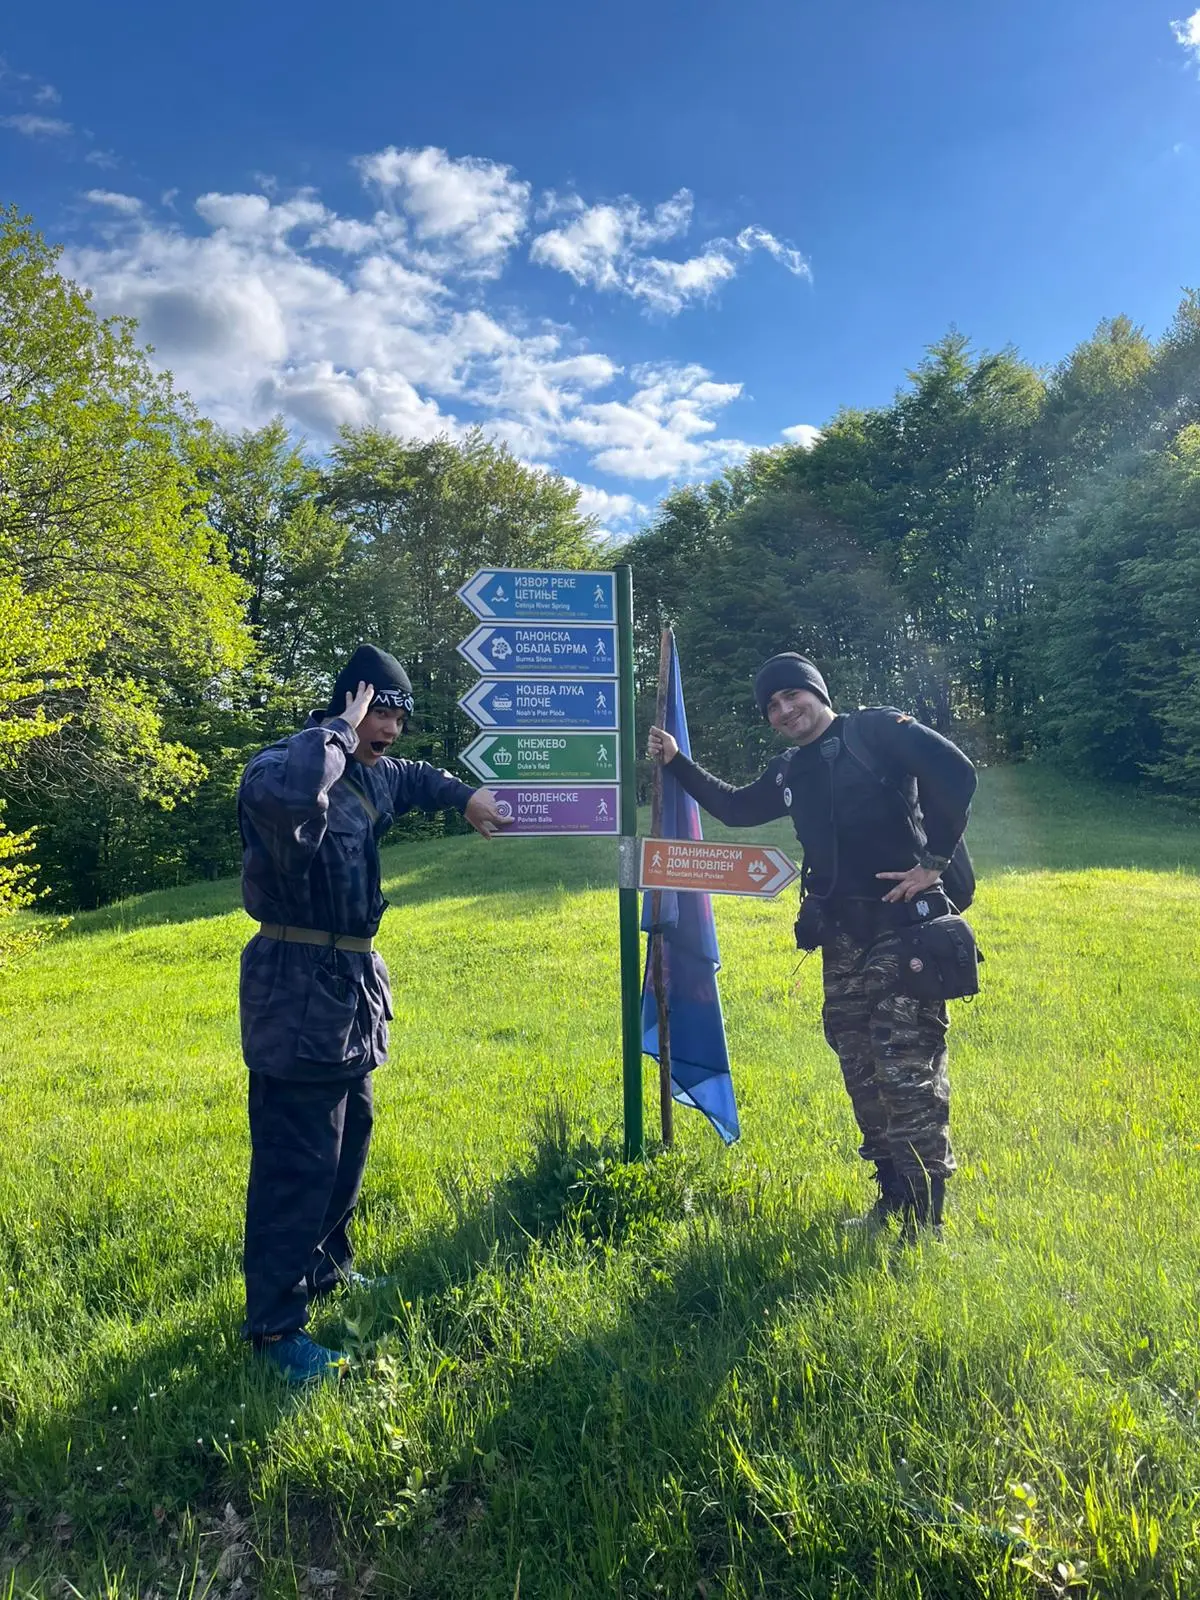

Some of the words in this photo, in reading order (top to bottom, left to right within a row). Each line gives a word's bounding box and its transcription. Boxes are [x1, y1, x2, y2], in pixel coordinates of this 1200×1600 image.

[515, 577, 548, 587] ИЗВОР
[551, 578, 576, 588] РЕКЕ
[515, 589, 557, 600] ЦЕТИЊЕ
[515, 631, 570, 641] ПАНОНСКА
[516, 643, 551, 653] ОБАЛА
[554, 644, 587, 654] БУРМА
[516, 685, 556, 695] НОЈЕВА
[559, 686, 584, 696] ЛУКА
[516, 697, 551, 707] ПЛОЧЕ
[517, 738, 567, 749] КНЕЖЕВО
[517, 751, 549, 761] ПОЉЕ
[517, 792, 579, 802] ПОВЛЕНСКЕ
[517, 804, 549, 814] КУГЛЕ
[667, 845, 743, 859] ПЛАНИНАРСКИ
[666, 858, 690, 869] ДОМ
[692, 859, 734, 871] ПОВЛЕН
